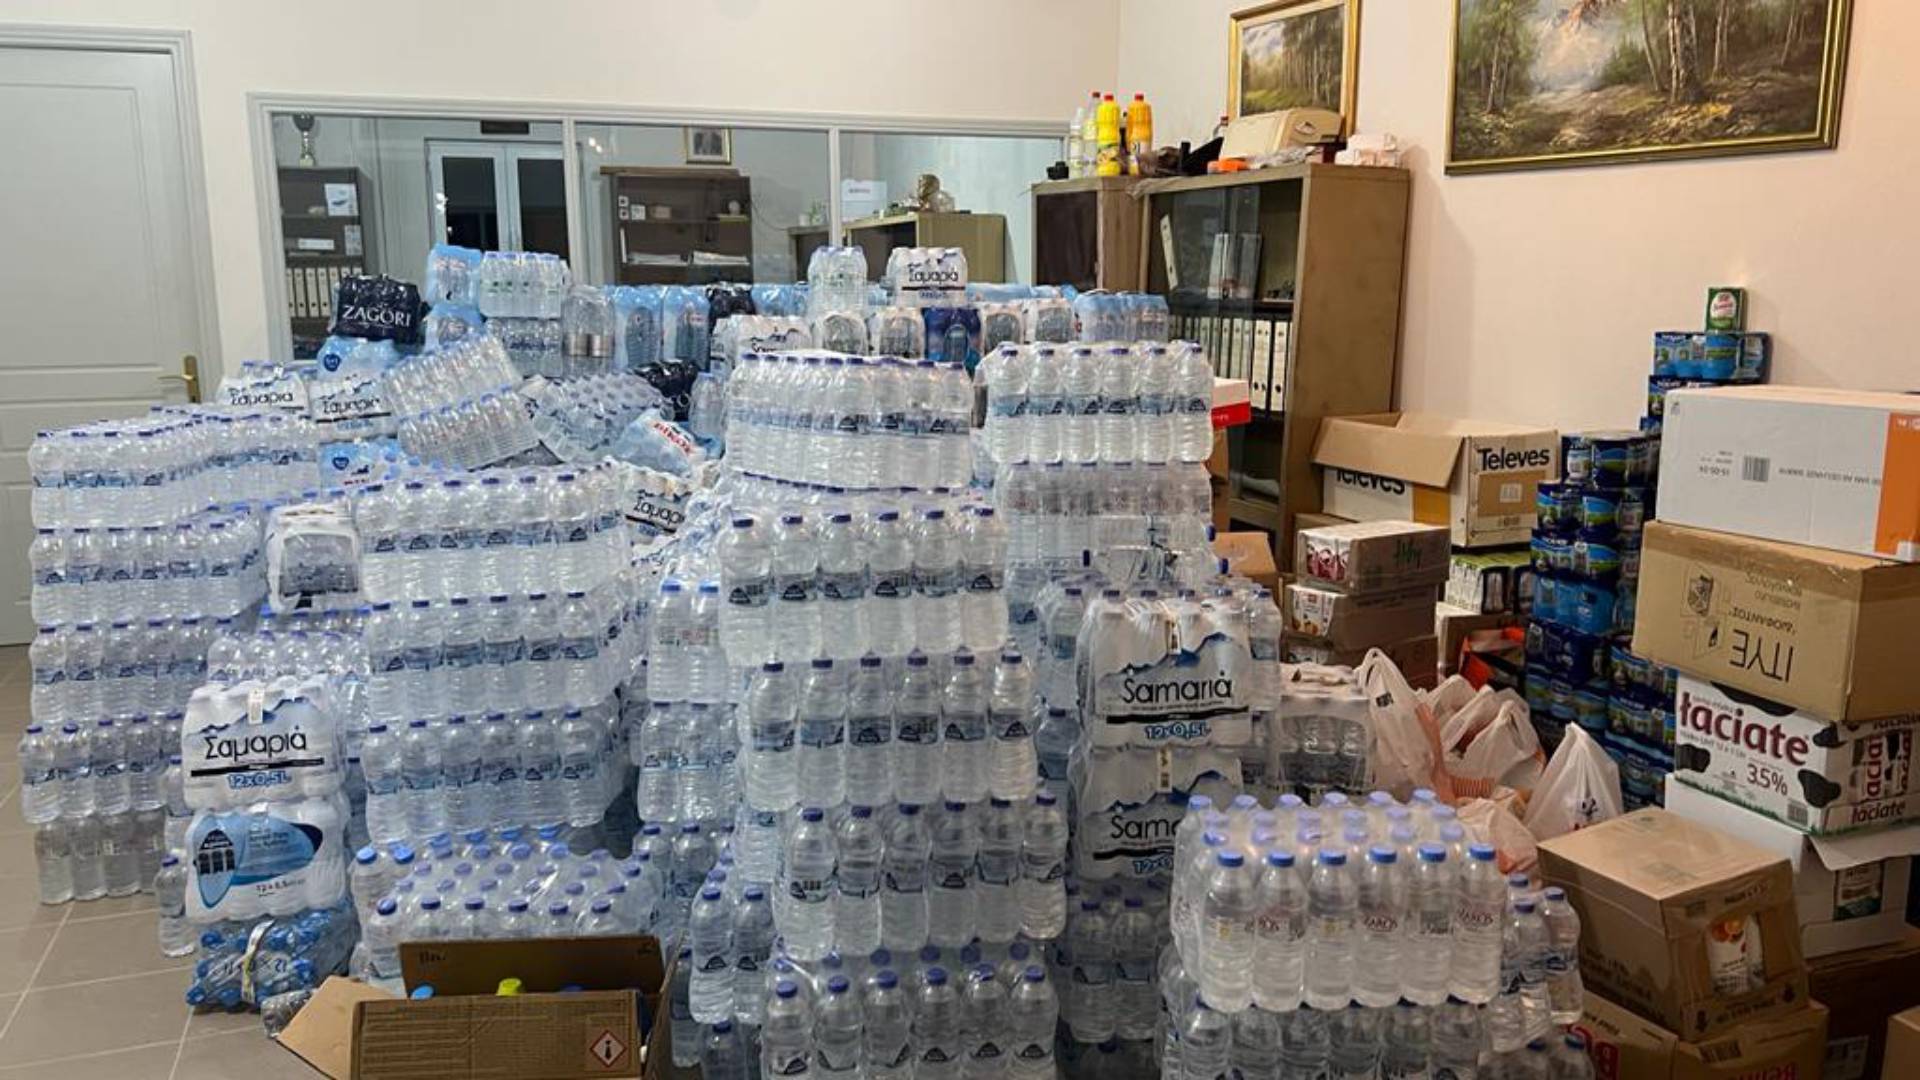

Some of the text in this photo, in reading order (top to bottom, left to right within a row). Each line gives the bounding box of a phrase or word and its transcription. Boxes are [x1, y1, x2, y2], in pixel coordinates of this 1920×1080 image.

[342, 305, 412, 329] ZAGORI
[1477, 447, 1550, 472] Televes
[204, 725, 307, 762] Σαμαριά
